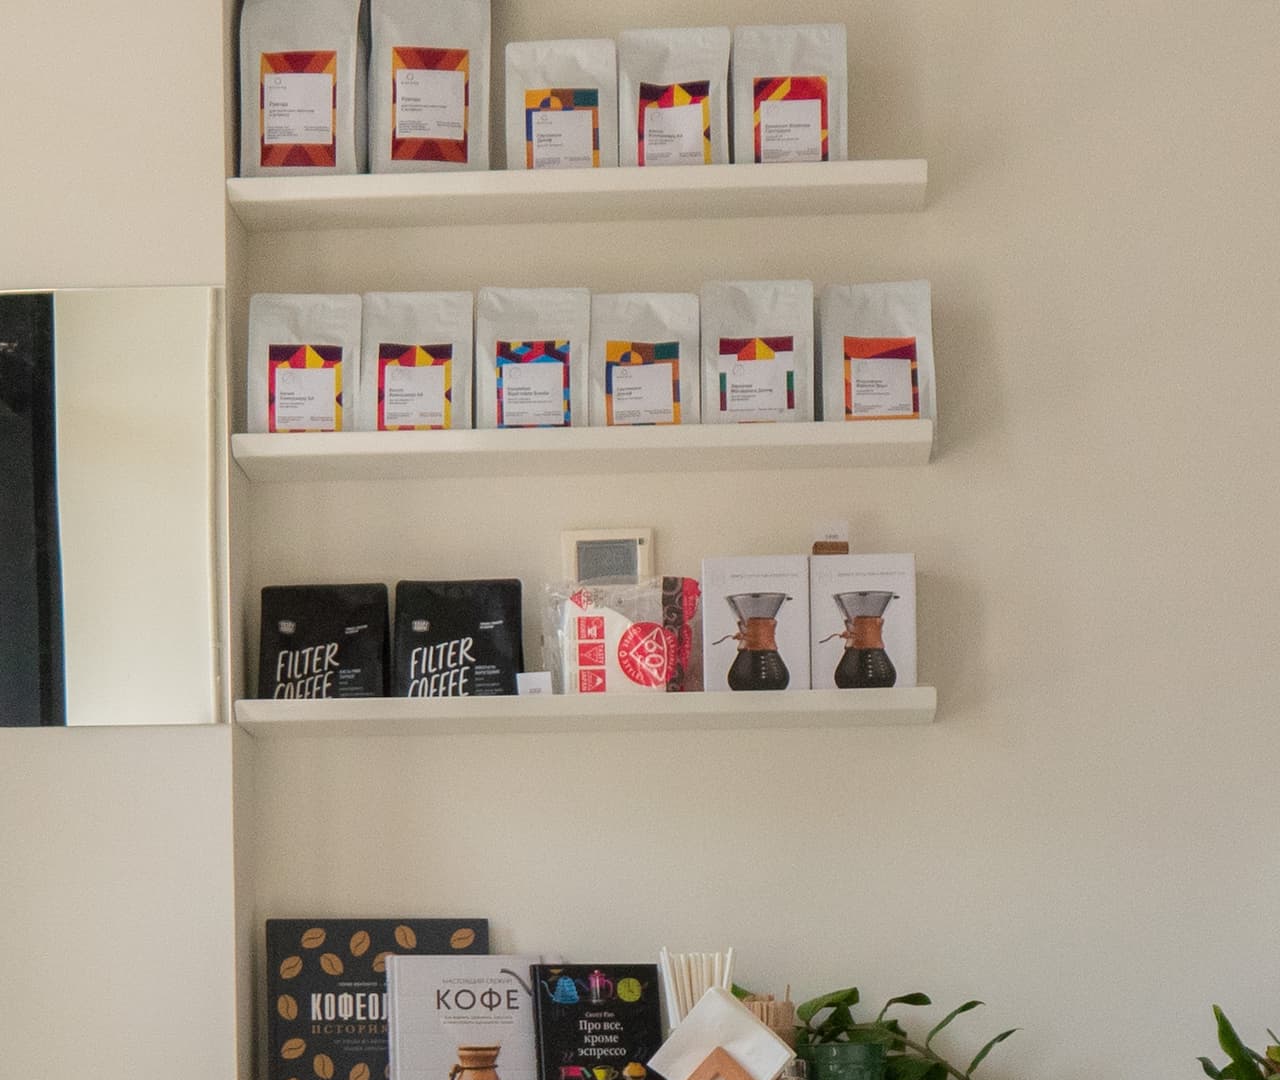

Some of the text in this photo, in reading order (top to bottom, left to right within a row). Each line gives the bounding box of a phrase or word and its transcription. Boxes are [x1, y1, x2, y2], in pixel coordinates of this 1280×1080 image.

[276, 642, 340, 682] FILTER
[410, 637, 477, 680] FILTER
[273, 671, 335, 699] COFFEE
[408, 666, 471, 698] COFFEE
[436, 987, 520, 1011] КОФЕ
[579, 1020, 624, 1033] Про все,
[577, 1047, 627, 1059] эспрессо
[584, 1034, 619, 1046] кроме
